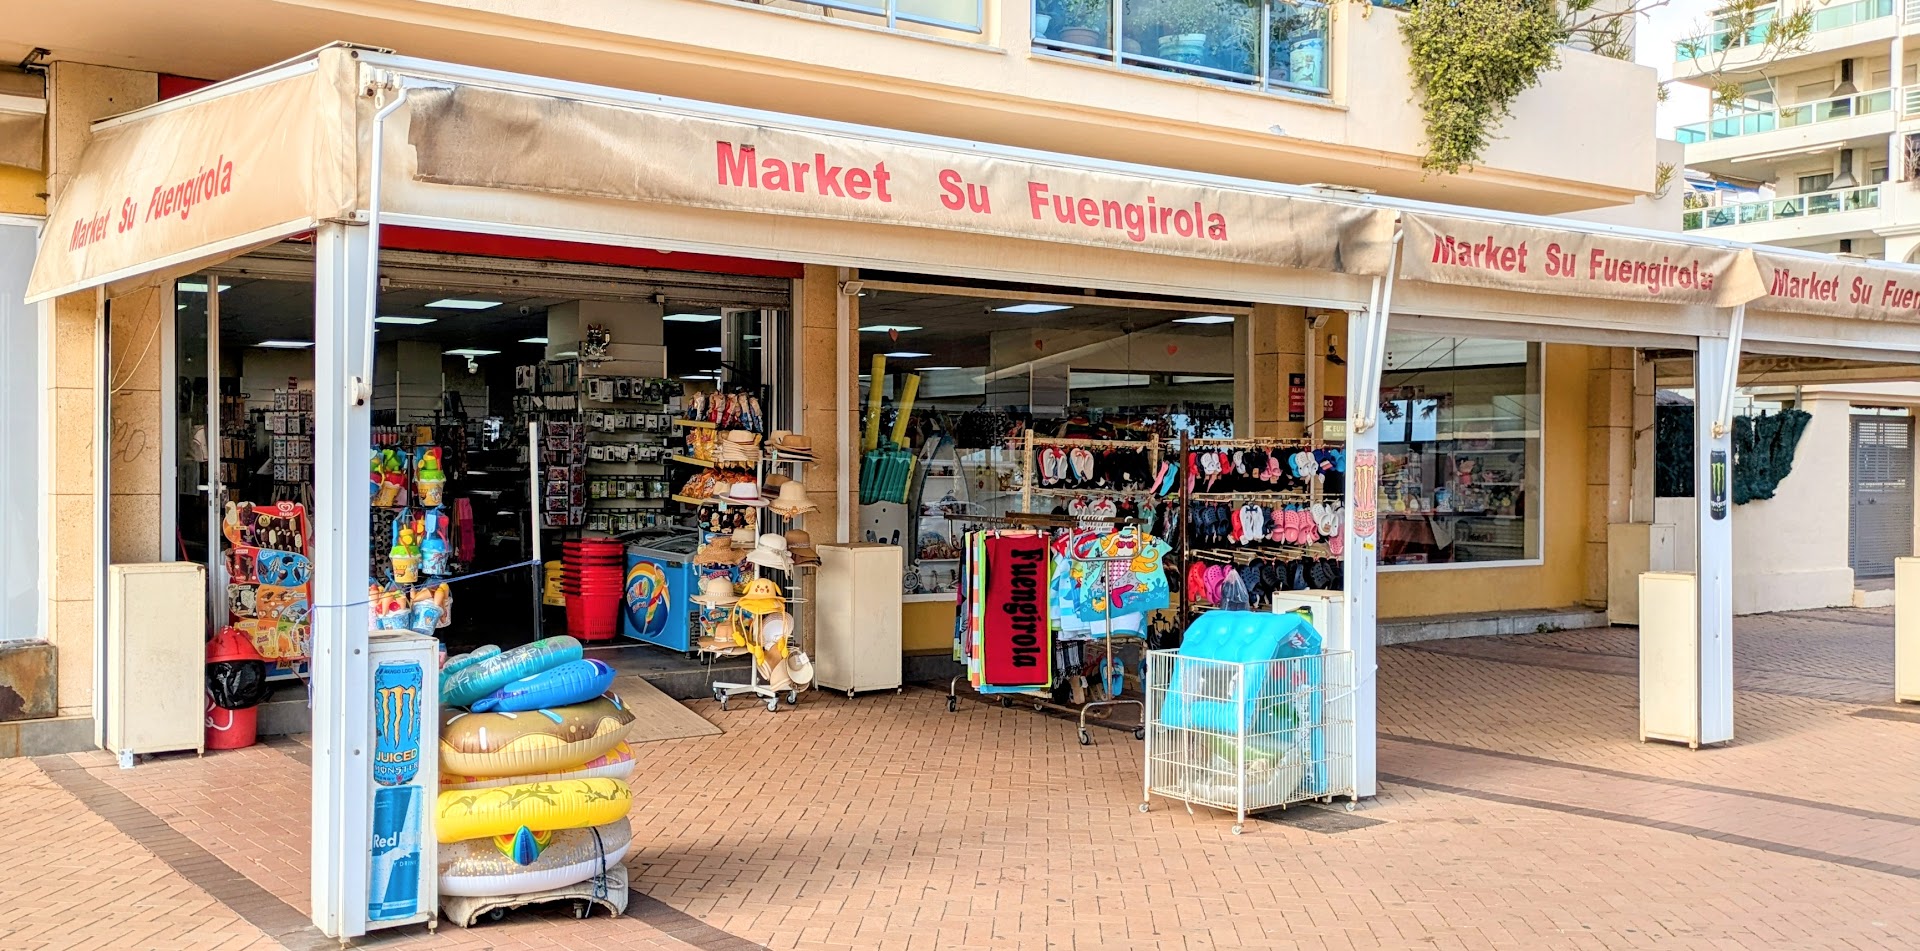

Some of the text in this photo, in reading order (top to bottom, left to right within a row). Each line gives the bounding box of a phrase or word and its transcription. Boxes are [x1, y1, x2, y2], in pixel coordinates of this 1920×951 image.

[69, 154, 233, 252] Market Su Fuengirola
[717, 141, 1227, 242] Market Su Fuengirola
[1432, 236, 1713, 294] Market Su Fuengirola
[1769, 267, 1839, 302] Market
[1850, 276, 1873, 305] Su
[1003, 549, 1043, 668] Fuengirola
[376, 748, 418, 764] JUICED
[373, 831, 396, 849] Red
